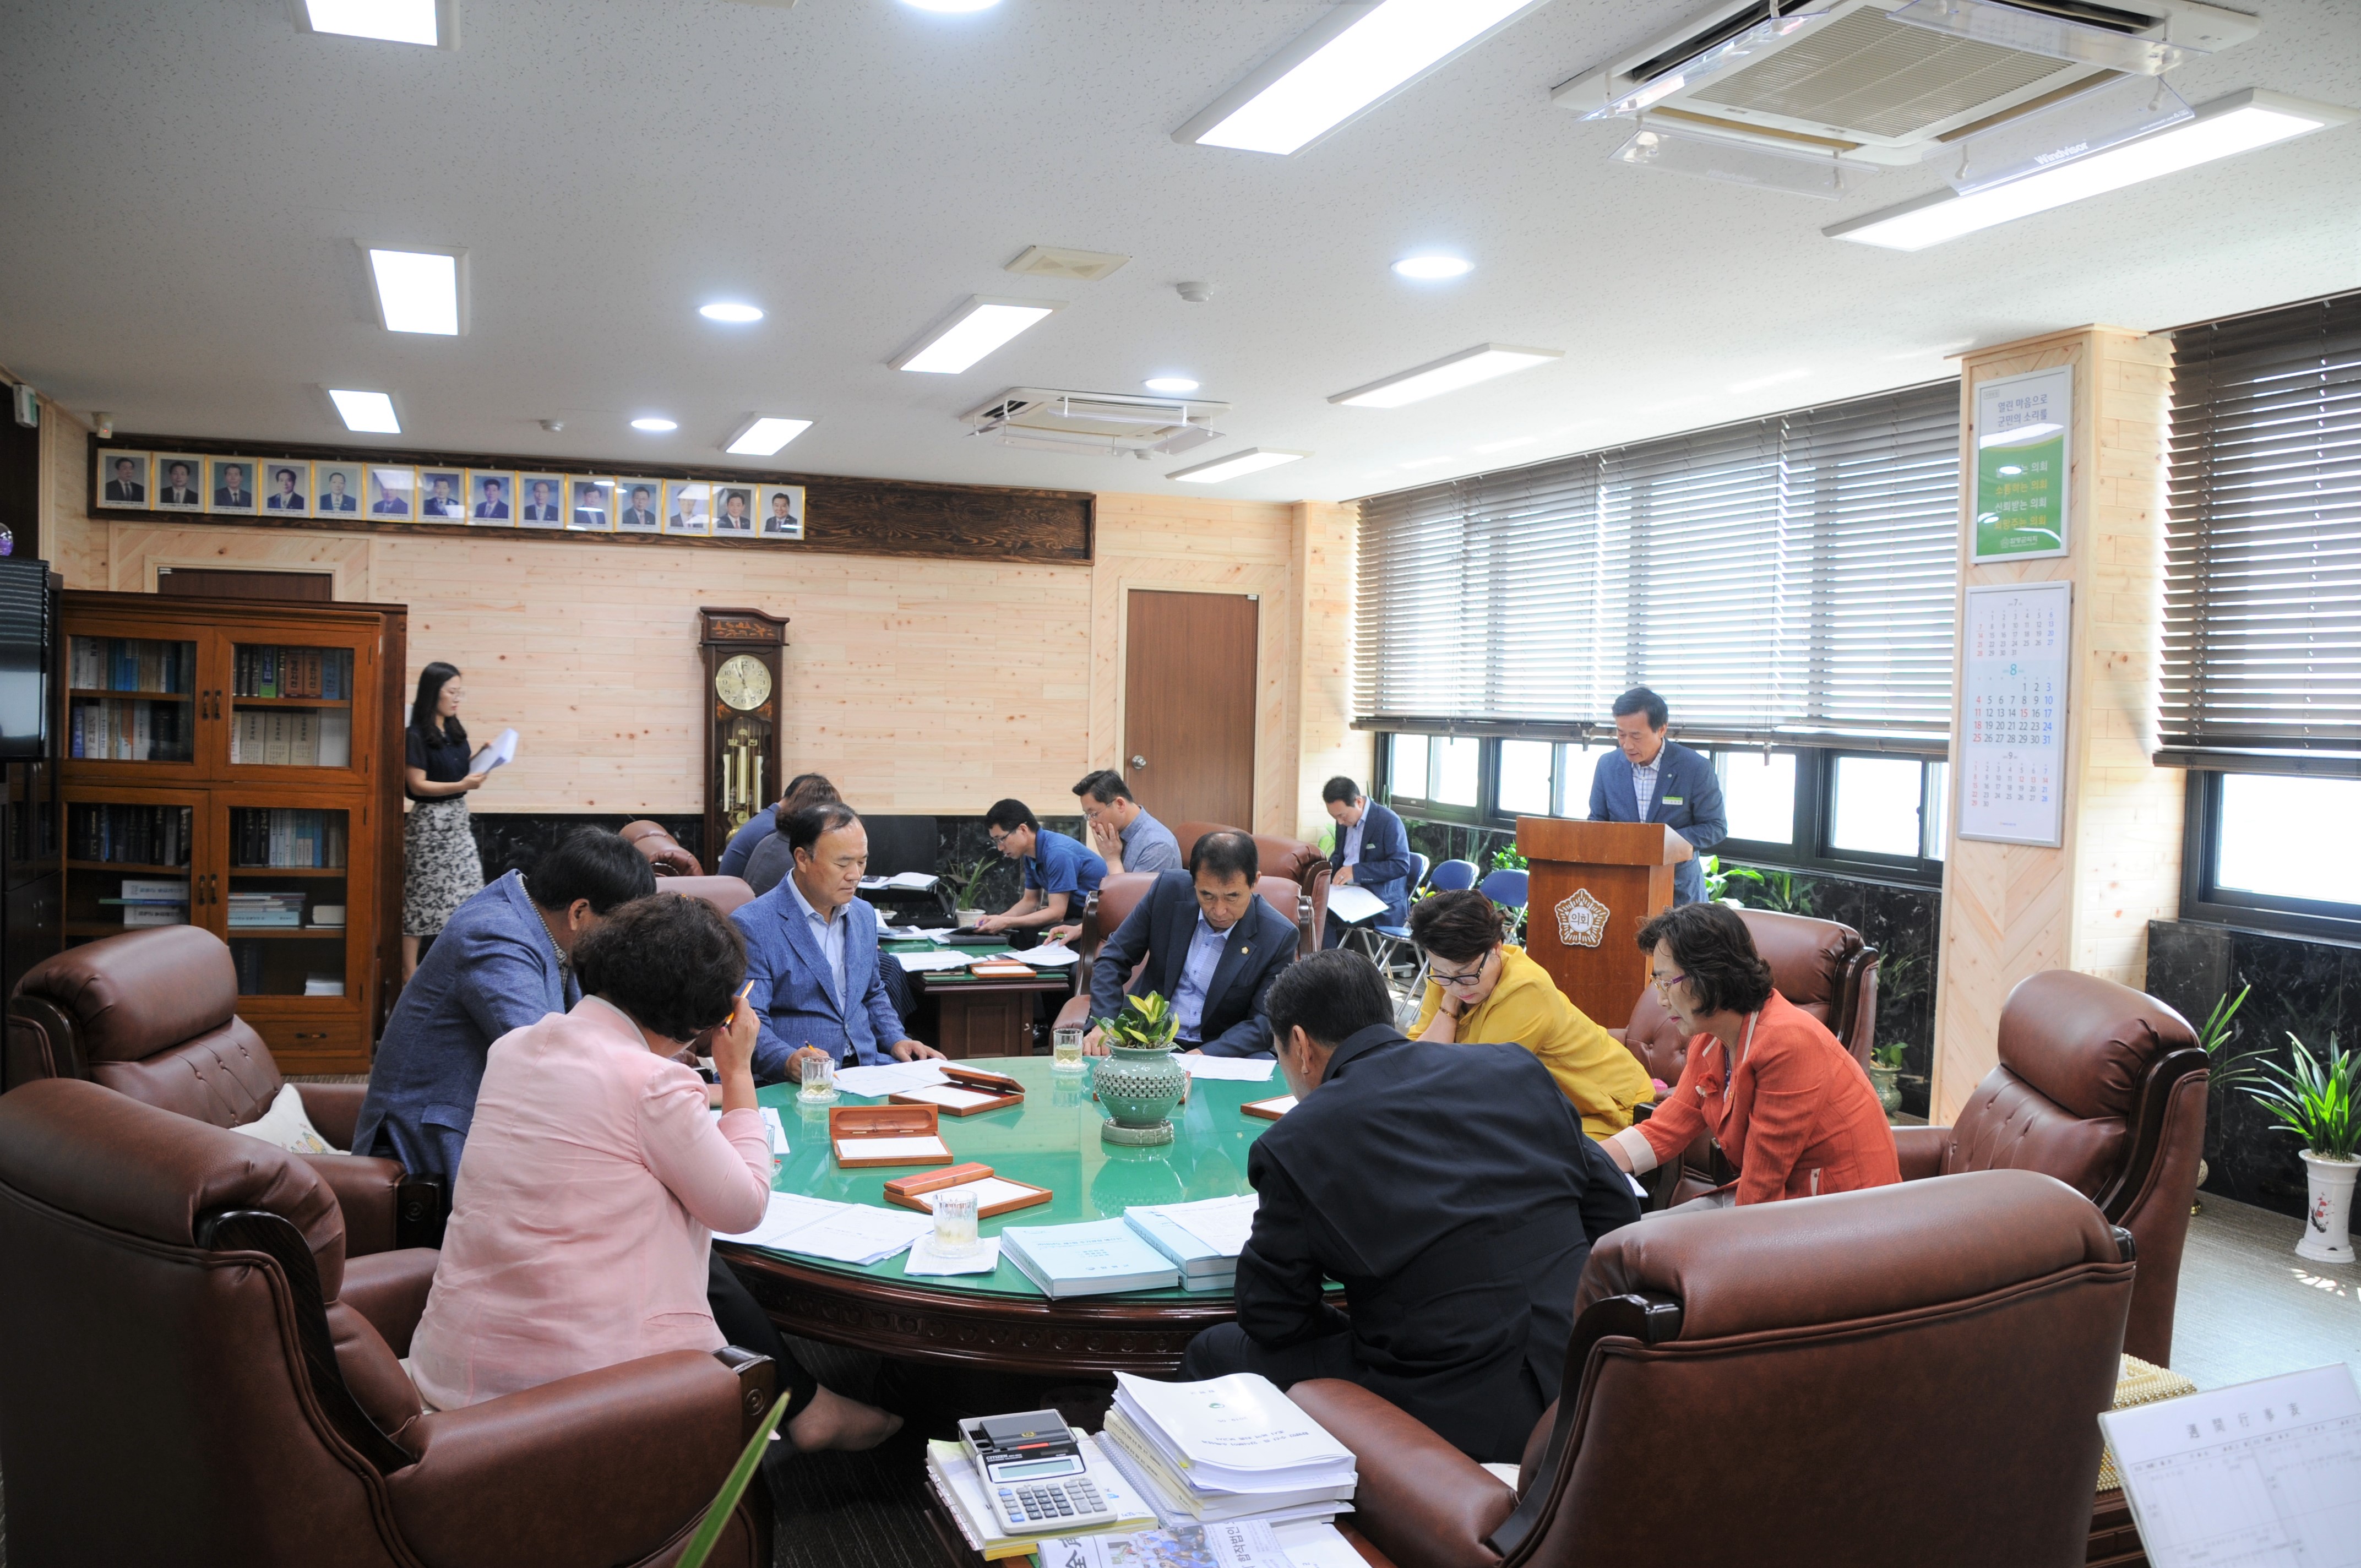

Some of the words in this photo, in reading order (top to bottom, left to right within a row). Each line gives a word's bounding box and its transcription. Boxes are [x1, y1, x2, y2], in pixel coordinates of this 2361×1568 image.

[2034, 141, 2088, 165] Windvisor
[1998, 400, 2014, 413] 열린
[2016, 394, 2048, 409] 마음으로
[1998, 413, 2021, 427] 군민의
[2023, 409, 2047, 422] 소리를
[2031, 460, 2048, 473] 의회
[1995, 481, 2028, 496] 소통하는
[2031, 478, 2047, 490] 의회
[1995, 499, 2027, 513] 신뢰받는
[2030, 497, 2047, 509] 의회
[2030, 515, 2046, 526] 의회
[2010, 663, 2017, 676] 8
[2022, 683, 2027, 691] 1
[2034, 683, 2039, 692] 2
[2046, 682, 2051, 692] 3
[1988, 695, 1992, 704] 5
[1999, 695, 2004, 704] 6
[2011, 695, 2015, 704] 7
[2022, 696, 2027, 705] 8
[2034, 696, 2039, 705] 9
[2045, 696, 2053, 705] 10
[1975, 708, 1981, 716] 11
[1986, 709, 1993, 717] 12
[1998, 709, 2005, 717] 13
[2009, 709, 2016, 717] 14
[2020, 709, 2028, 717] 15
[2032, 709, 2040, 717] 16
[2044, 709, 2052, 717] 17
[1974, 721, 1982, 729] 18
[1985, 721, 1993, 729] 19
[1996, 721, 2005, 730] 20
[2008, 721, 2015, 730] 21
[2019, 722, 2028, 731] 22
[2031, 722, 2039, 731] 23
[2043, 722, 2052, 731] 24
[1973, 733, 1981, 742] 25
[1984, 733, 1993, 742] 26
[1995, 734, 2004, 743] 27
[2007, 734, 2016, 743] 28
[2019, 734, 2027, 743] 29
[2031, 735, 2039, 744] 30
[2043, 735, 2050, 744] 31
[1571, 912, 1590, 926] 의회
[2186, 1402, 2300, 1439] 週間行事表
[1225, 1526, 1252, 1562] 합작법인
